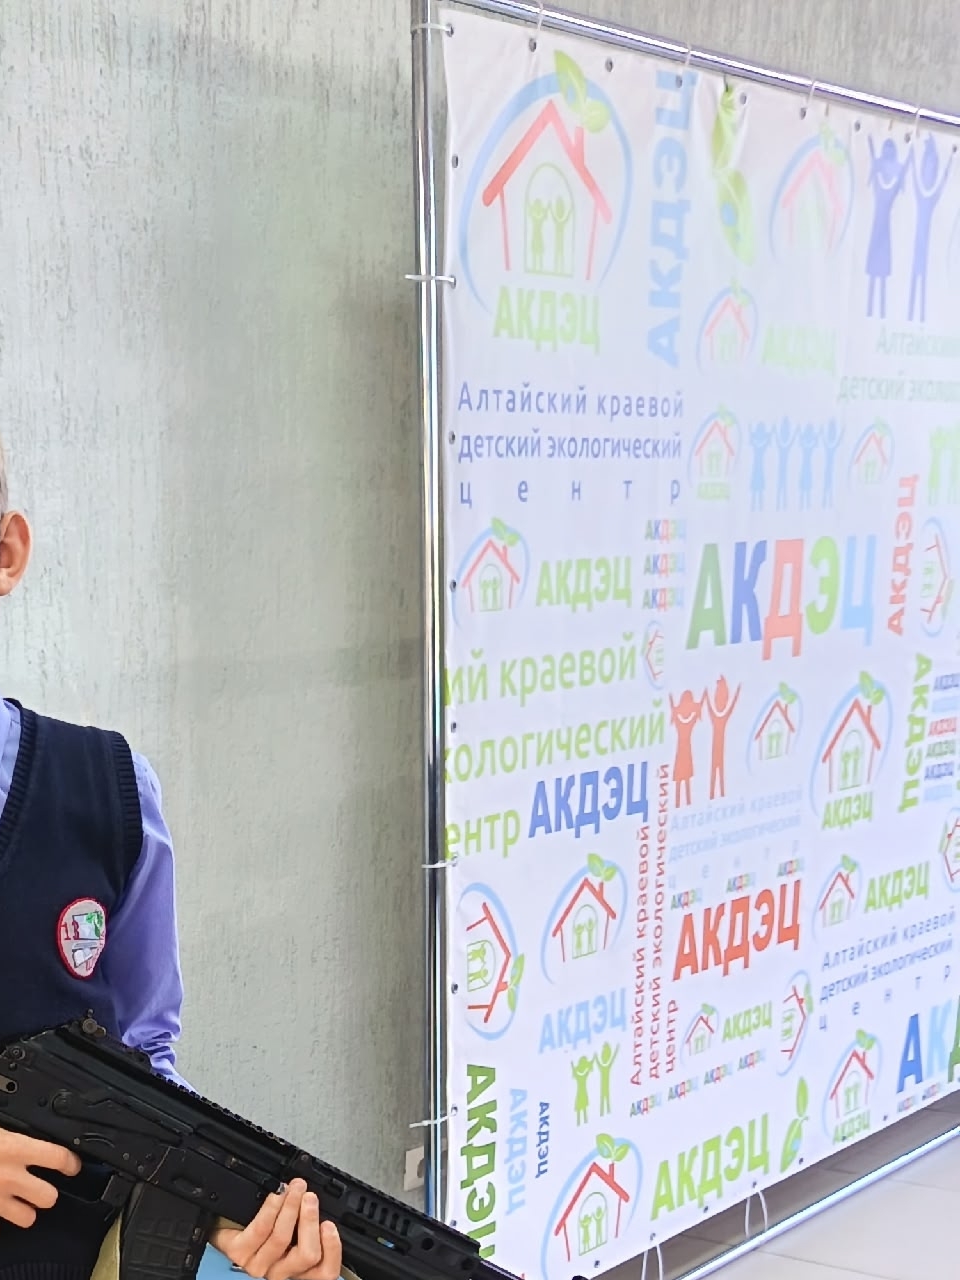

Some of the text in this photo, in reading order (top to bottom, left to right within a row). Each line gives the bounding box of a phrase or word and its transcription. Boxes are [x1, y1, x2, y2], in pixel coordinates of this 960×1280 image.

[647, 70, 699, 369] АКДЭЦ
[493, 286, 600, 355] АКДЭЦ
[458, 381, 683, 421] Алтайский краевой
[458, 428, 682, 463] детский экологический
[536, 556, 633, 613] АКДЭЦ
[887, 474, 919, 636] АКДЭЦ
[686, 534, 877, 661] АКДЭЦ
[500, 631, 637, 707] краевой
[898, 653, 932, 813] АКДЭЦ
[528, 761, 648, 839] АКДЭЦ
[821, 791, 874, 830] АКДЭЦ
[649, 764, 670, 1079] детский экологический
[864, 860, 930, 914] АКДЭЦ
[630, 825, 650, 1085] Алтайский краевой
[672, 879, 801, 982] АКДЭЦ
[821, 926, 897, 972] Алтайский
[538, 988, 627, 1054] АКДЭЦ
[665, 1000, 678, 1073] центр
[721, 1001, 772, 1043] АКДЭЦ
[504, 1088, 528, 1216] АКДЭЦ
[535, 1101, 550, 1178] АКДЭЦ
[650, 1113, 769, 1221] АКДЭЦ
